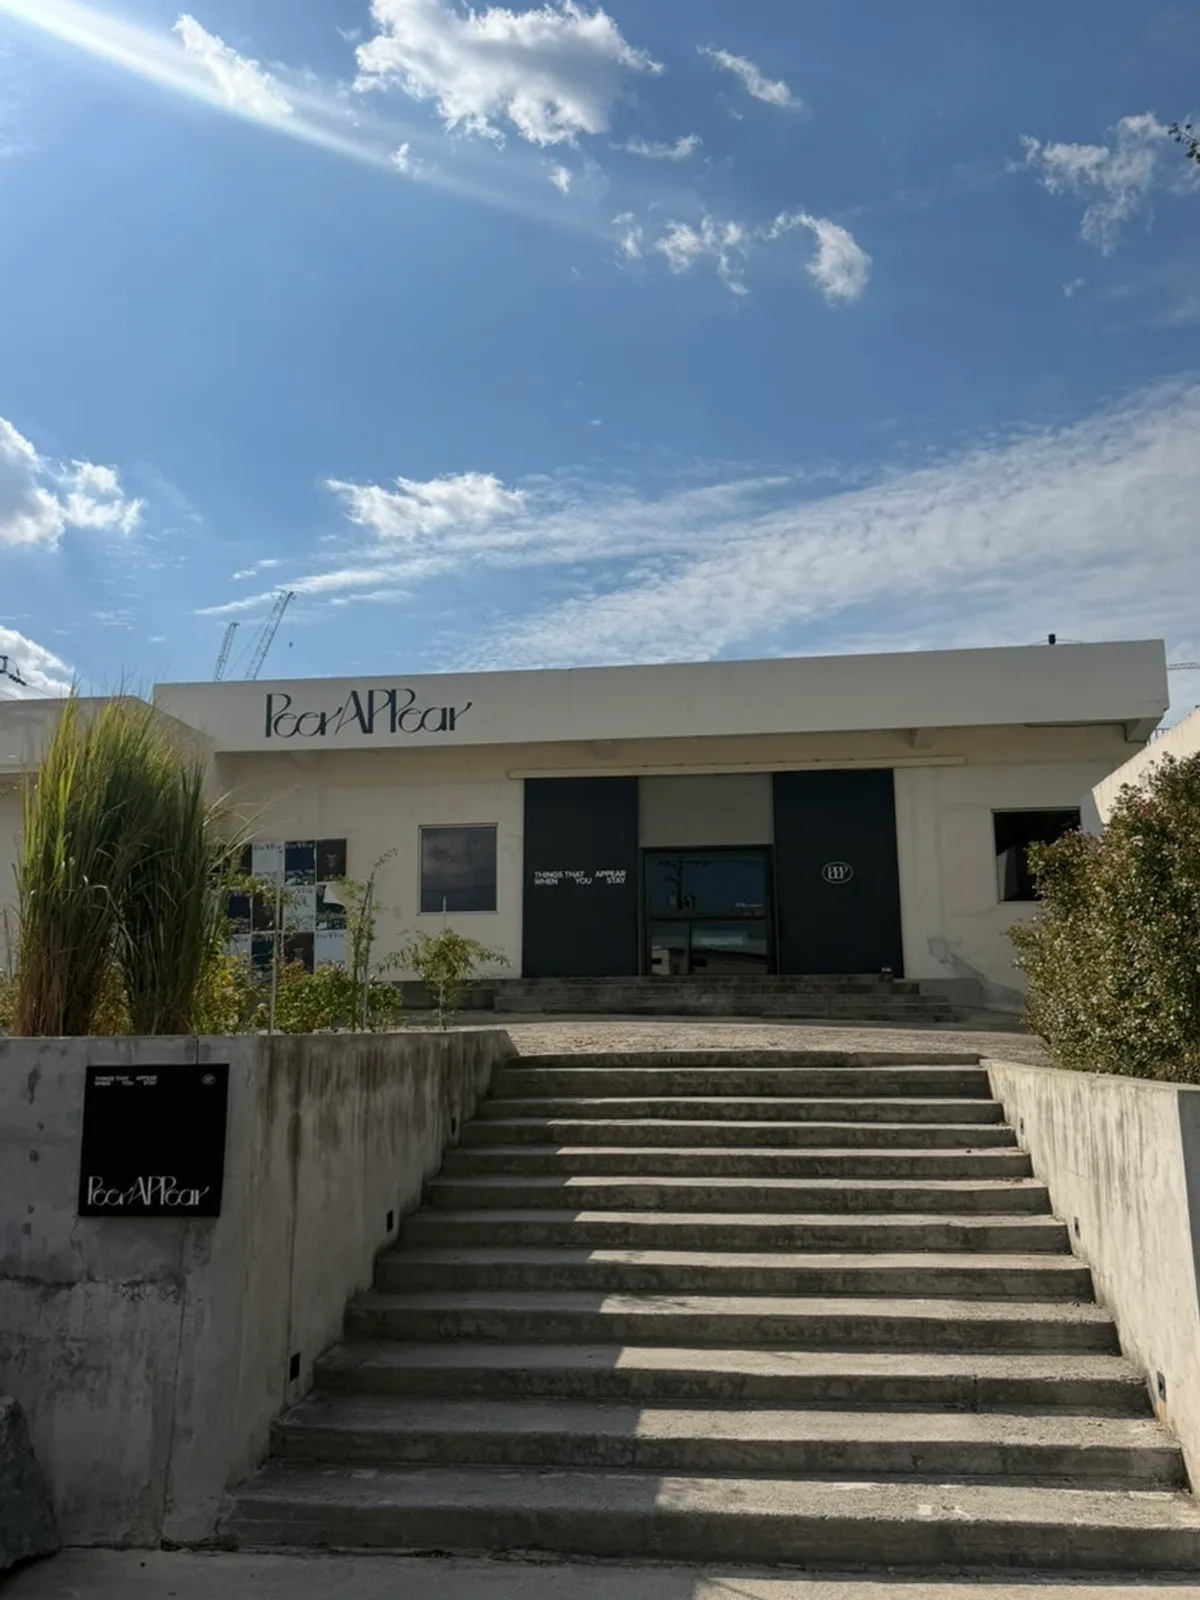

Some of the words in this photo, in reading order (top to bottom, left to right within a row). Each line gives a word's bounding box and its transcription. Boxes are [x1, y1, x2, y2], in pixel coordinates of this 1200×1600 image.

[565, 870, 584, 878] THAT
[595, 869, 626, 877] APPEAR
[576, 877, 592, 885] YOU
